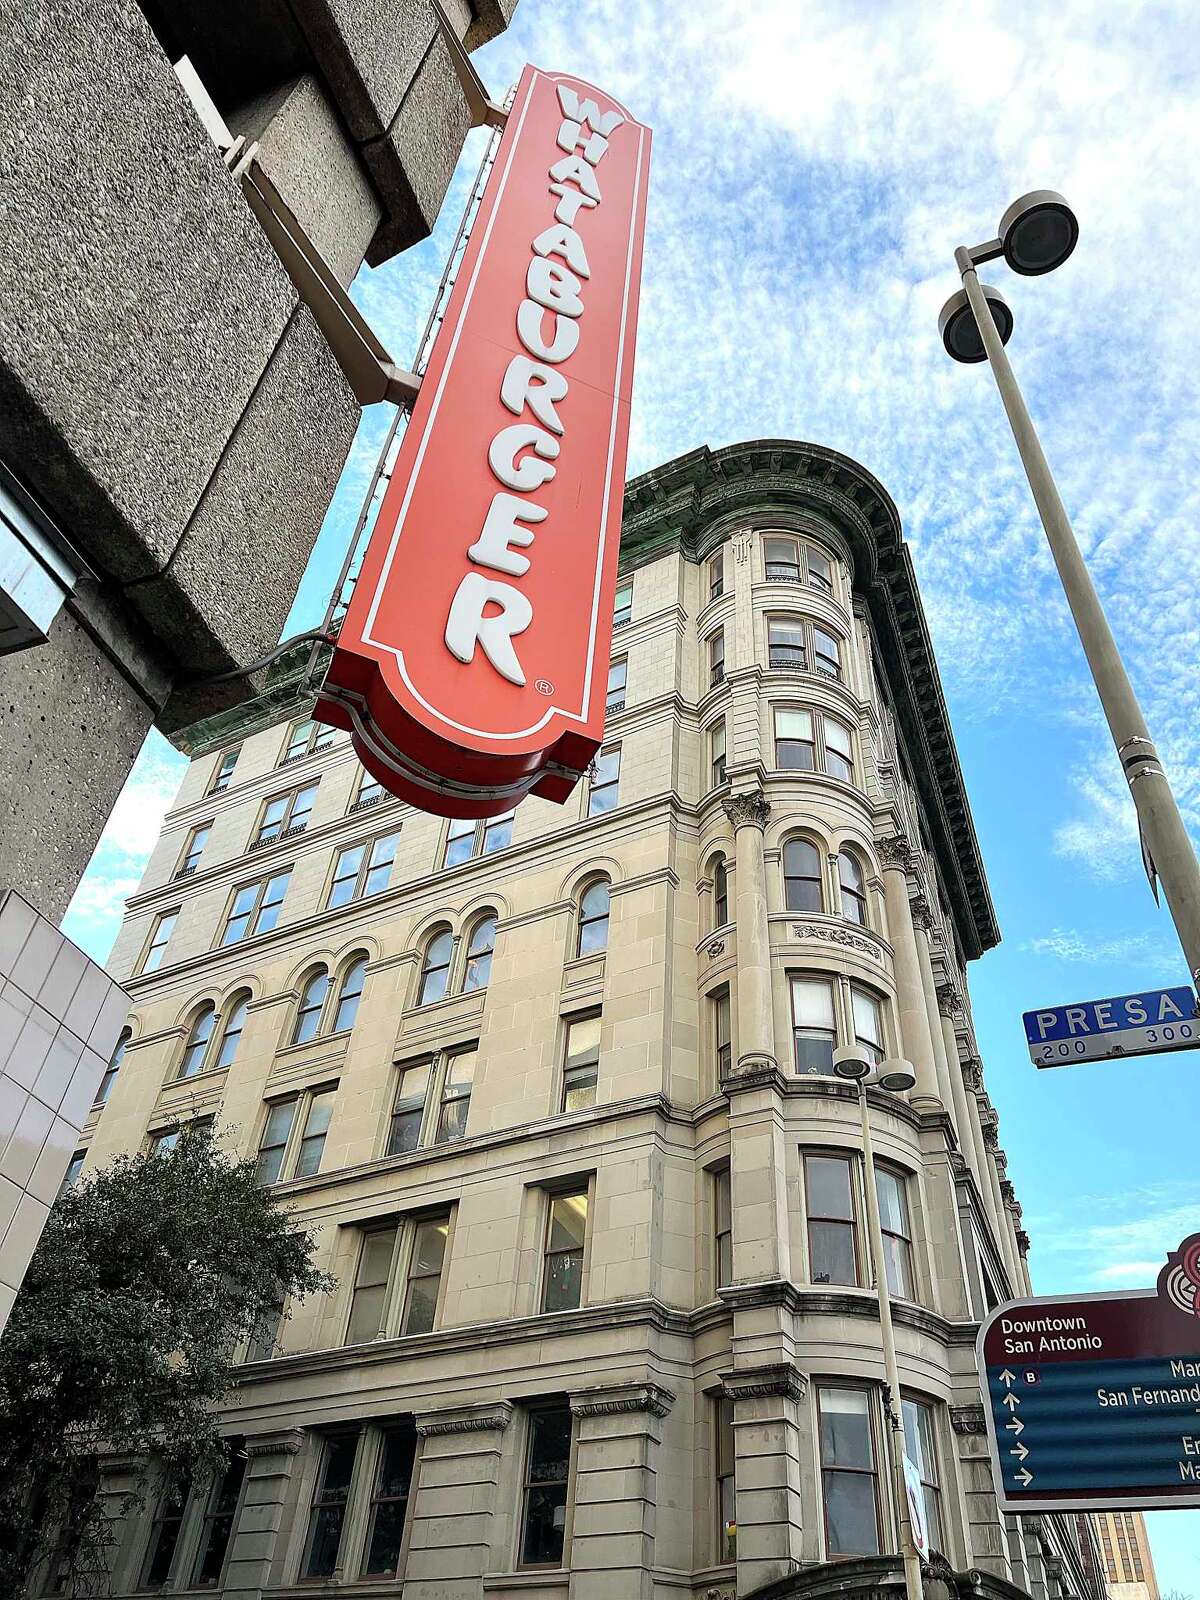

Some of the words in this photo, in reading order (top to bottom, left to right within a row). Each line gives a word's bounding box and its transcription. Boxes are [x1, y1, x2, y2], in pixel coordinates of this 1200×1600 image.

[443, 83, 625, 688] WHATABURGER
[1036, 993, 1183, 1039] PRESA
[1042, 1040, 1086, 1059] 200
[1145, 1024, 1192, 1043] 300
[1001, 1317, 1087, 1334] Downtown
[1004, 1338, 1034, 1354] San
[1039, 1334, 1103, 1352] Antonio
[1026, 1372, 1036, 1383] B
[1097, 1388, 1128, 1407] San
[1131, 1383, 1200, 1405] Fernand
